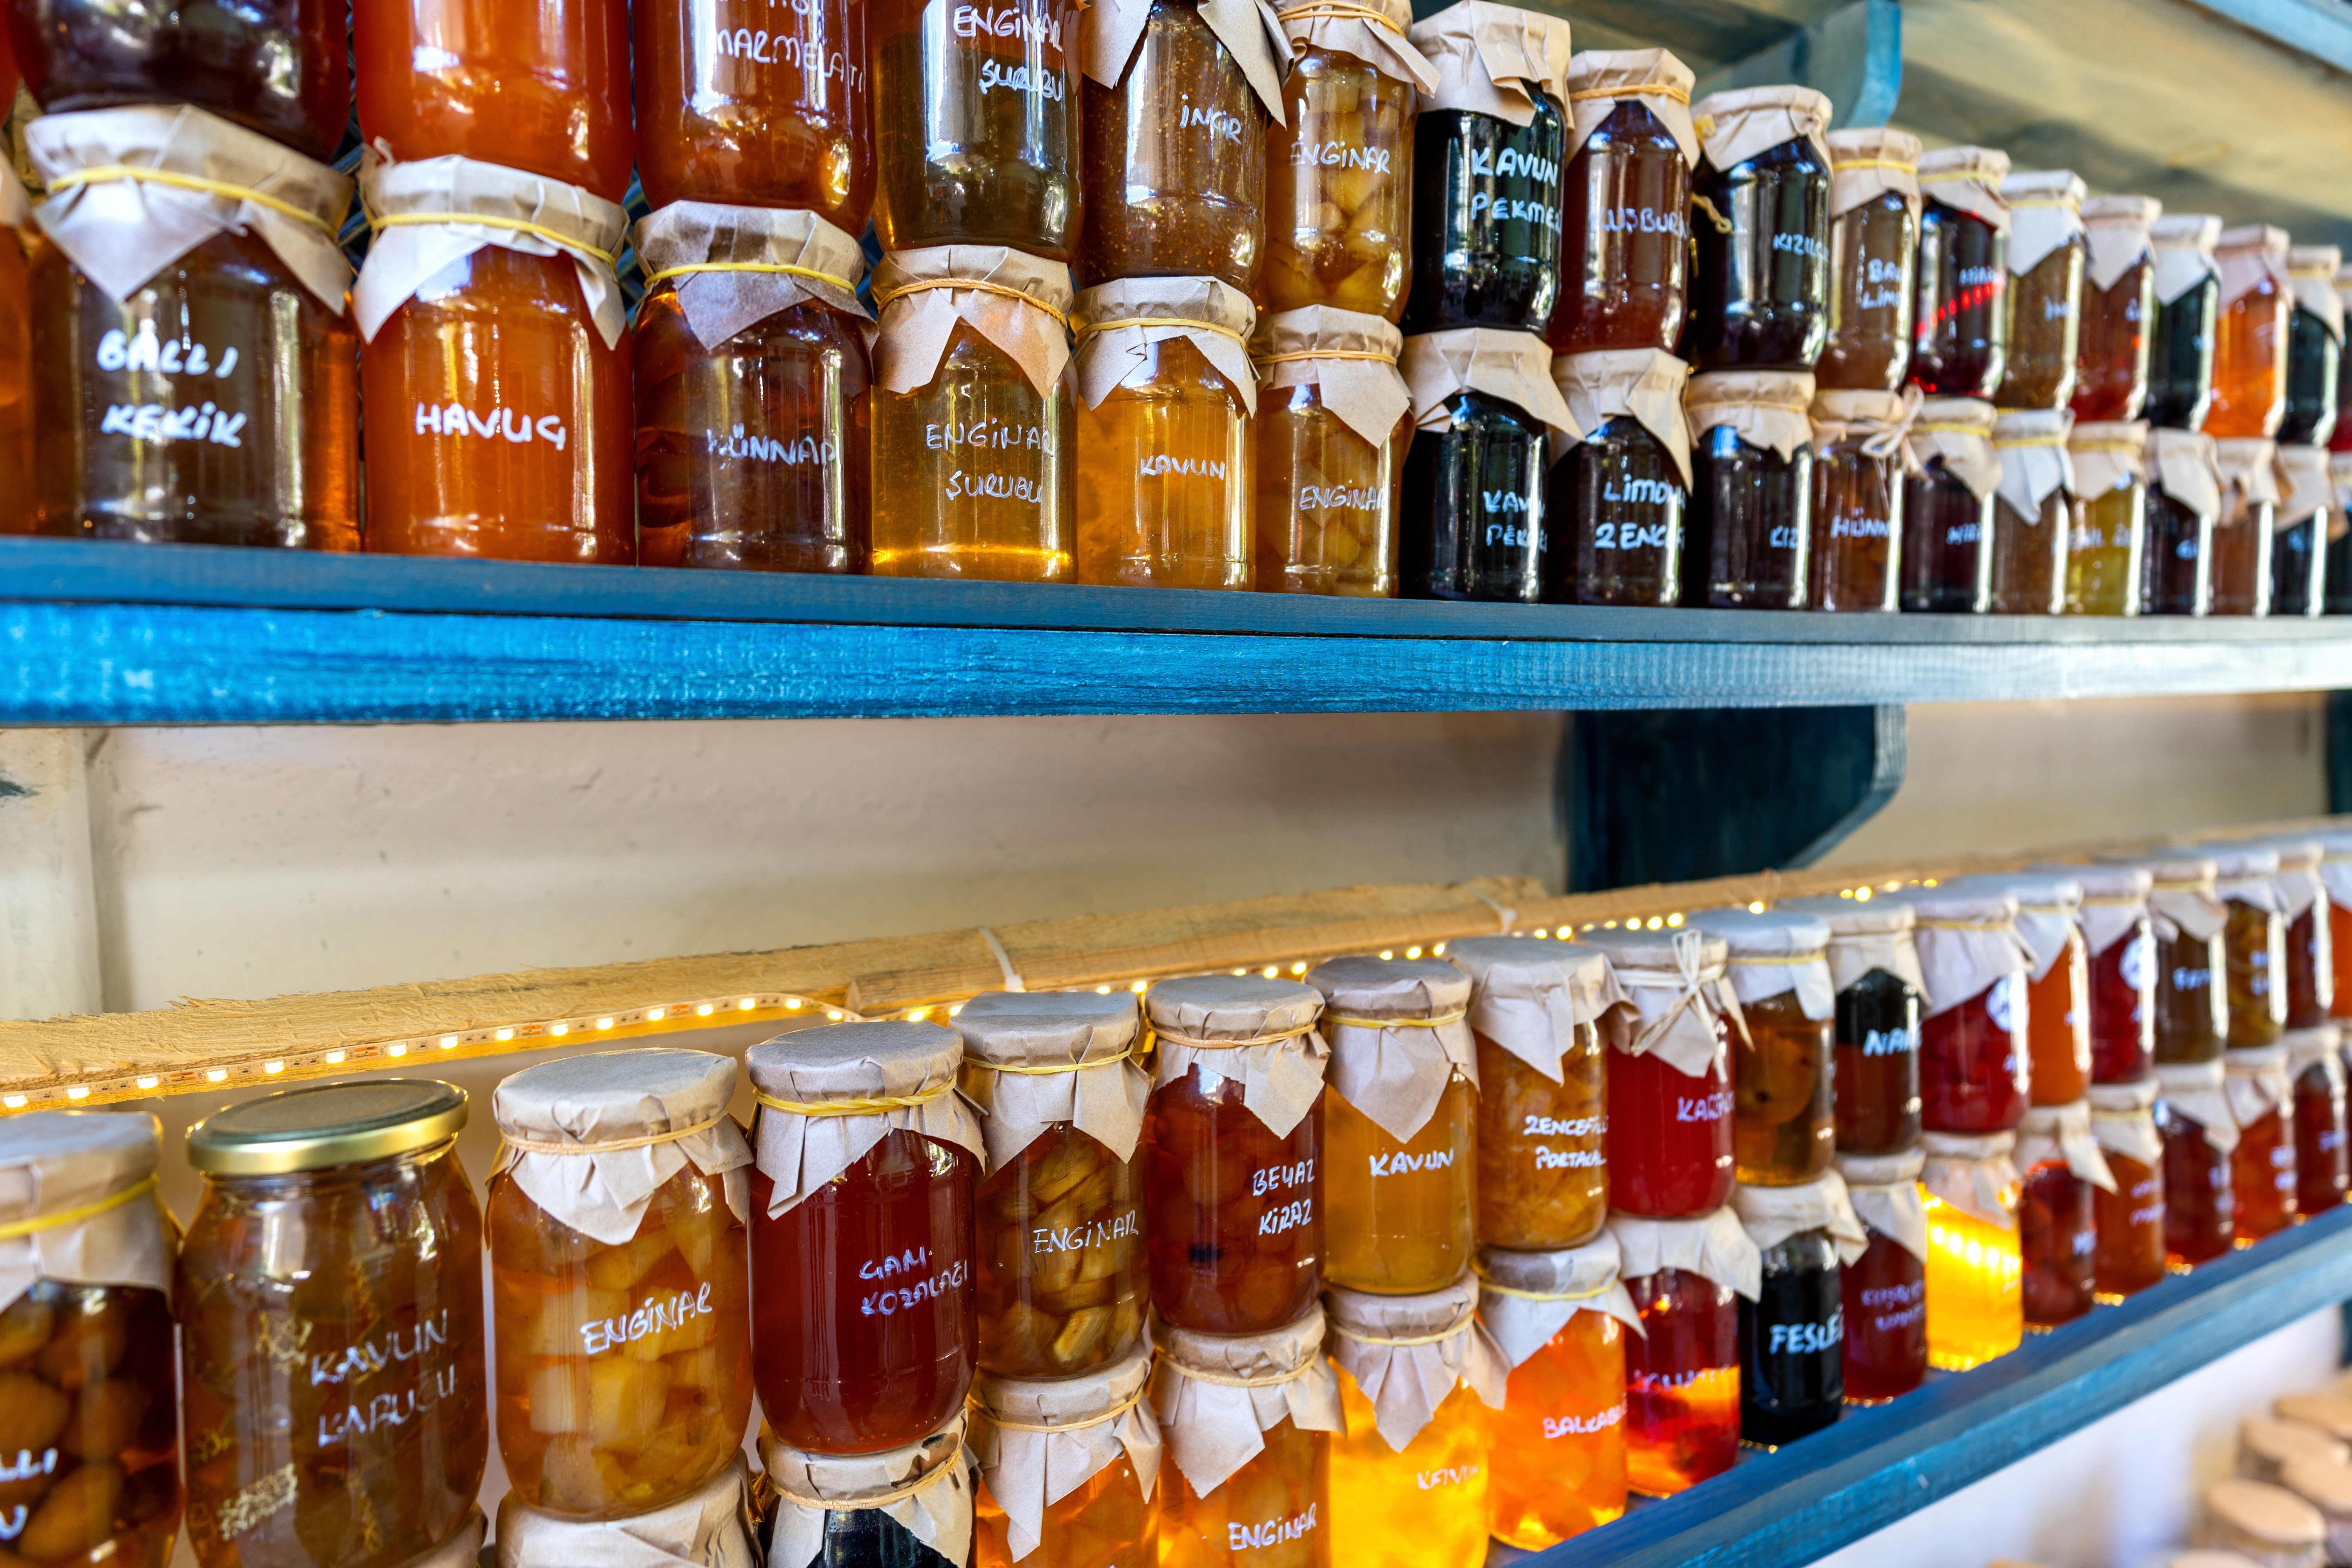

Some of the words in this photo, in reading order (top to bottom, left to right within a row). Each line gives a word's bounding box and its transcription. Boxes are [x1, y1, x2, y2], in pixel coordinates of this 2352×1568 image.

[1471, 147, 1559, 187] KAVUN
[1141, 454, 1225, 480] KAVUN
[1252, 1158, 1315, 1196] BEYAZ
[1369, 1149, 1454, 1177] KAVUN
[580, 1281, 713, 1355] ENGİNAR
